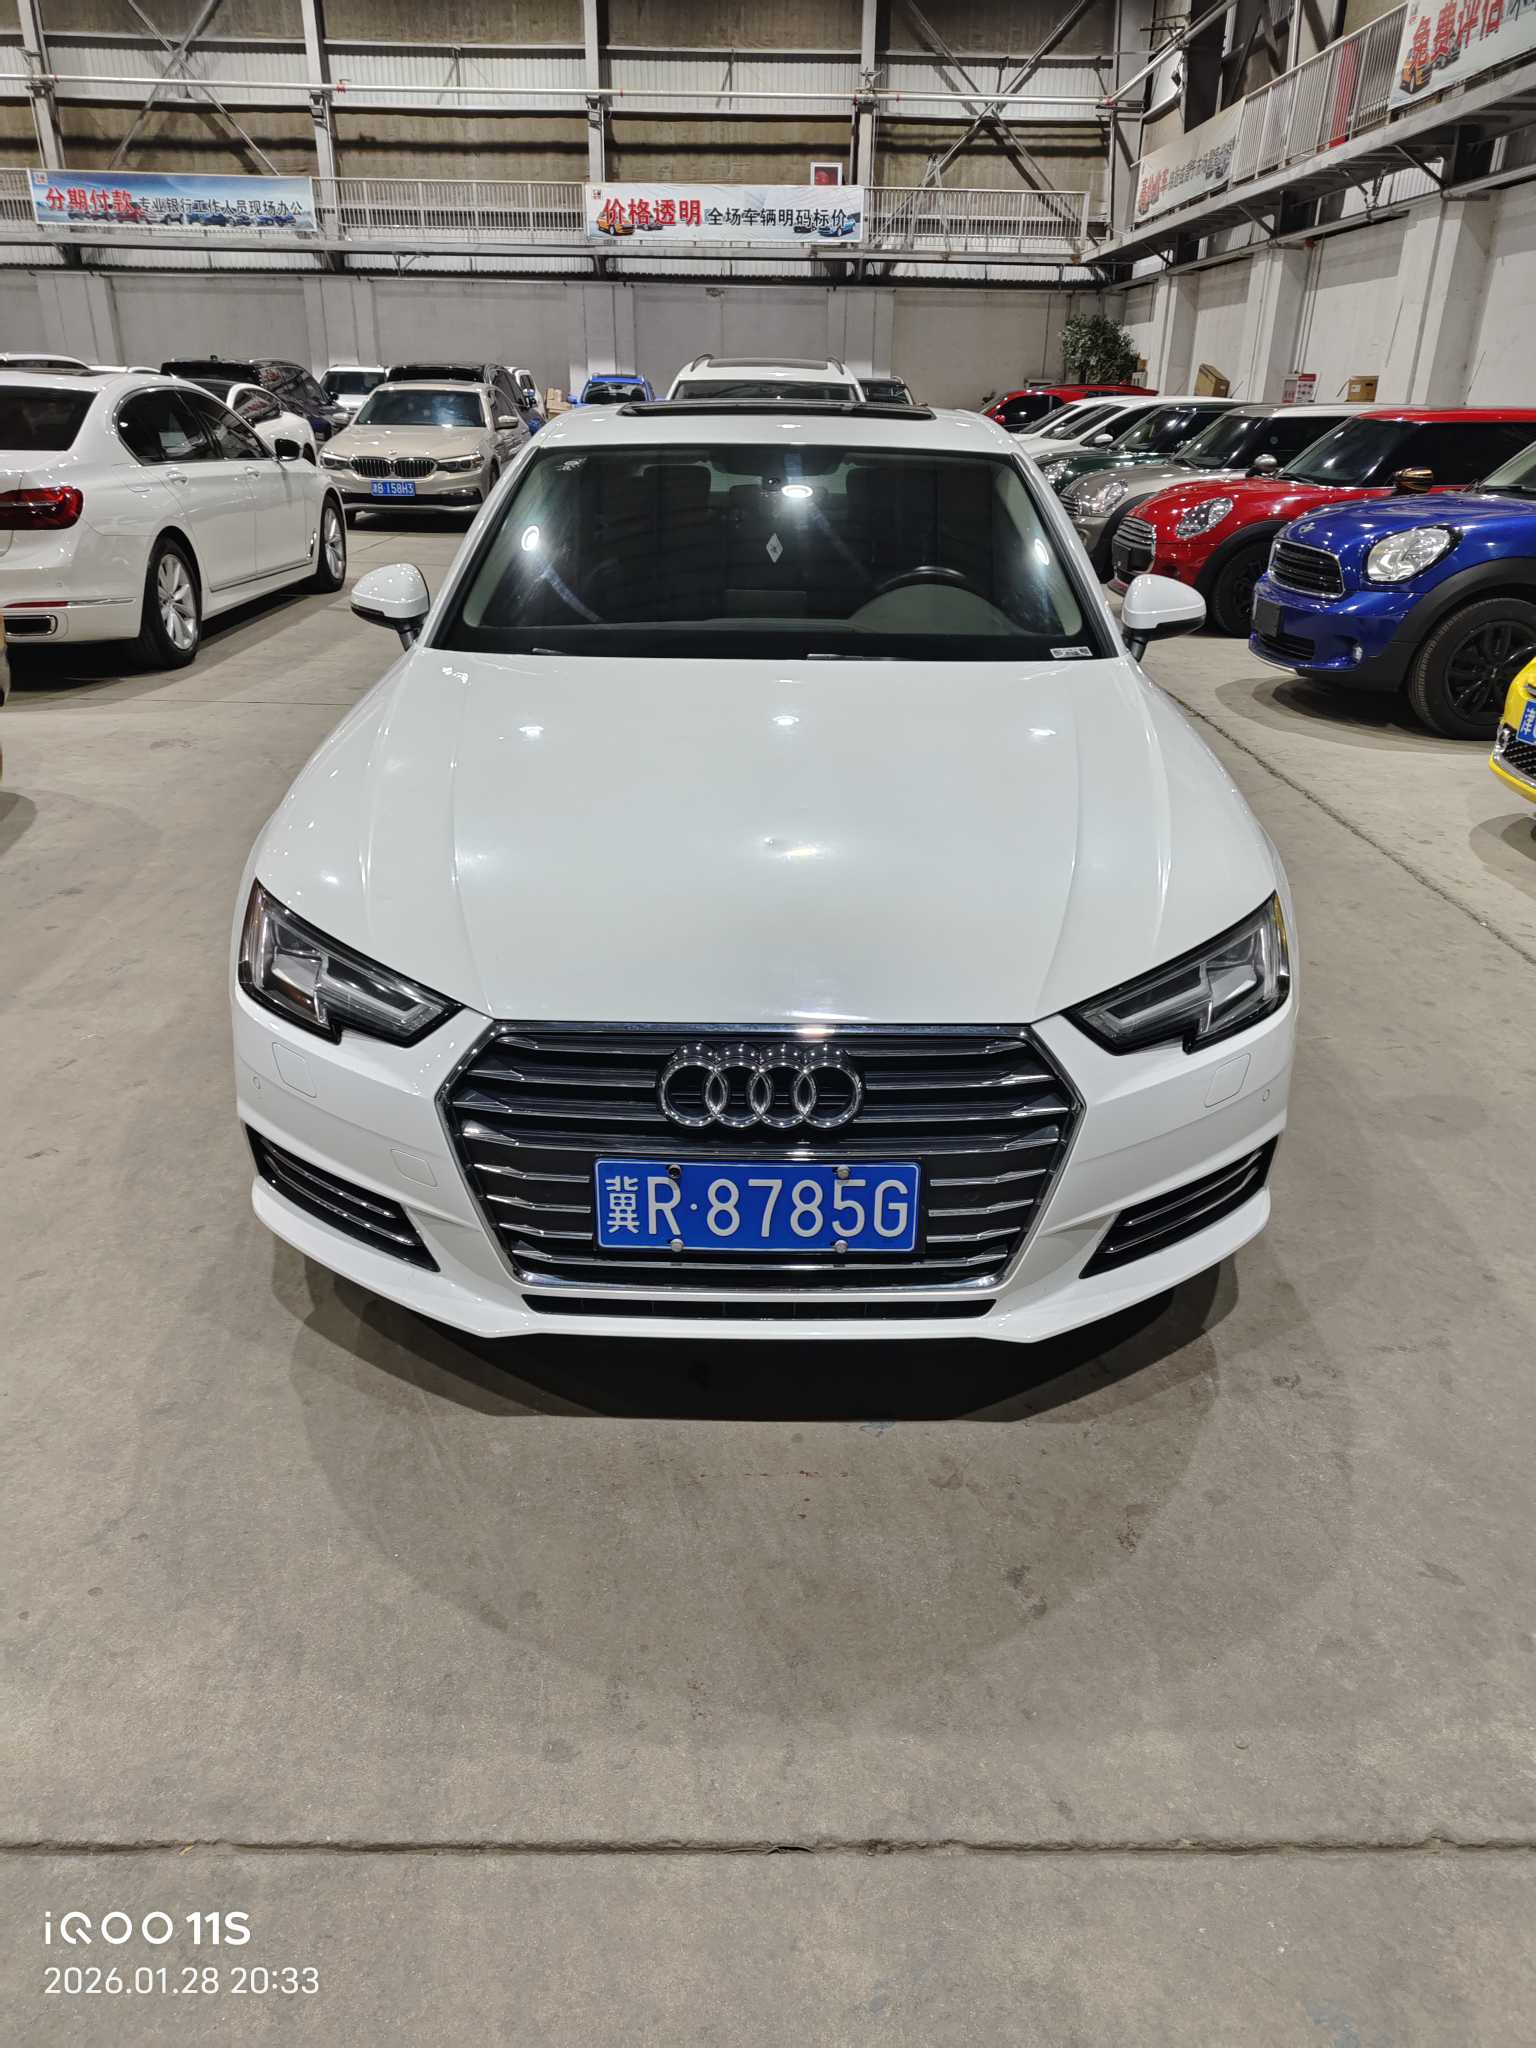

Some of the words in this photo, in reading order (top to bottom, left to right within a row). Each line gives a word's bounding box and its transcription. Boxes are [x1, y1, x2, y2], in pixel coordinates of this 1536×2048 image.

[46, 187, 133, 213] 分期付款
[138, 196, 303, 217] 专业银行工作人员现场办公
[603, 198, 703, 226] 价格透明
[707, 207, 847, 228] 全场车辆明码标价
